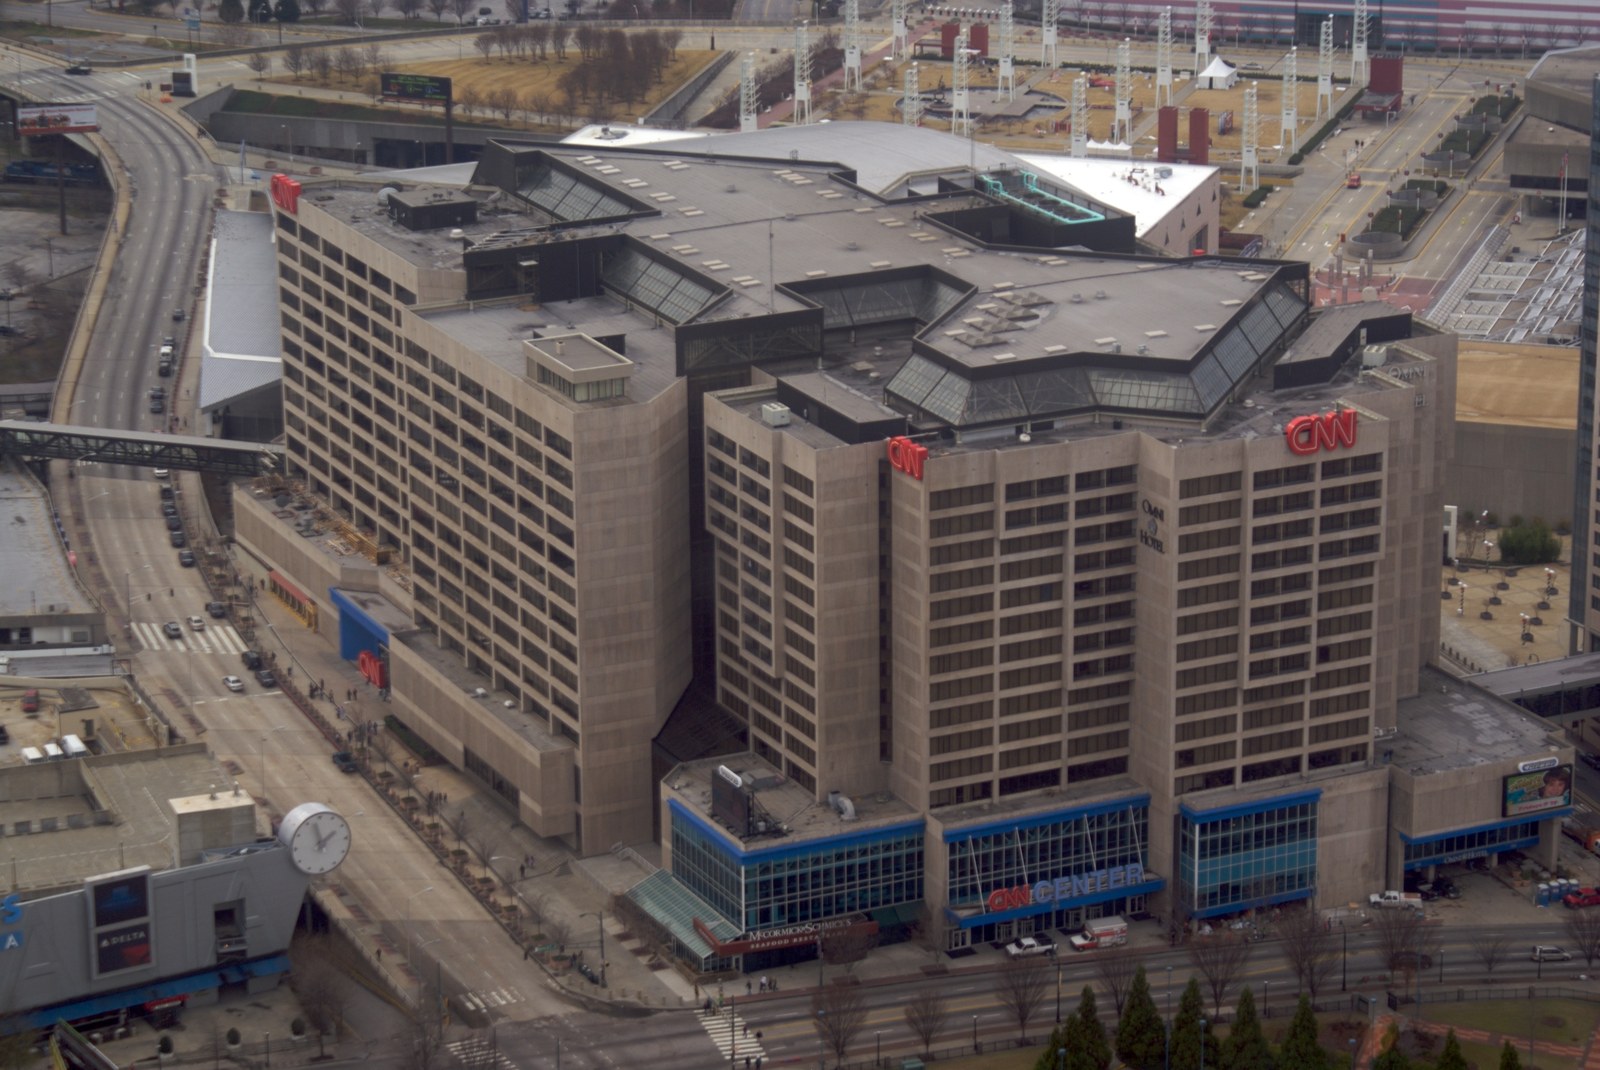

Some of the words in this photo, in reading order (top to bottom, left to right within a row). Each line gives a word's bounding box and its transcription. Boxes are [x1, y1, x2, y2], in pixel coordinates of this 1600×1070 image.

[1285, 408, 1358, 456] CNN
[886, 435, 929, 481] CNN
[357, 650, 385, 689] CNN
[988, 884, 1030, 911] CNN
[1033, 862, 1144, 904] CENTER
[111, 931, 146, 946] DELTA
